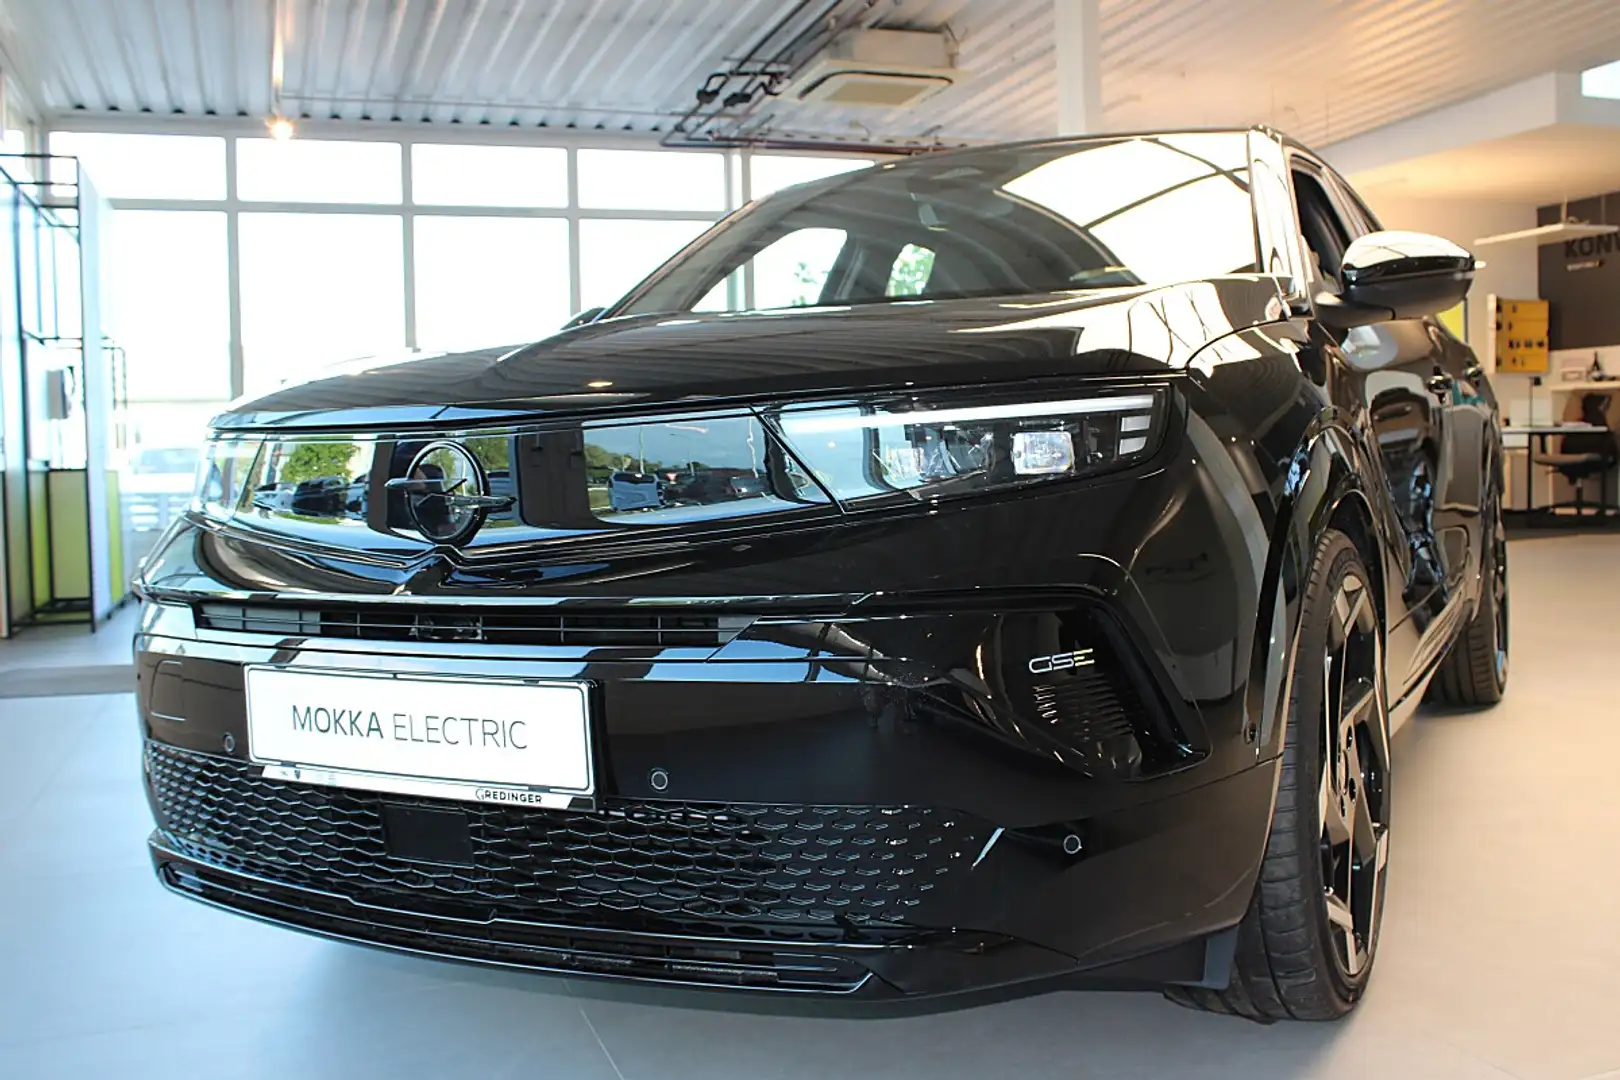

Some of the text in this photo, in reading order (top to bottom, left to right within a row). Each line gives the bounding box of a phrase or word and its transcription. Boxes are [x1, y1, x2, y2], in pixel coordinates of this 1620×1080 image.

[1028, 648, 1096, 674] GSE
[292, 704, 528, 750] MOKKA ELECTRIC
